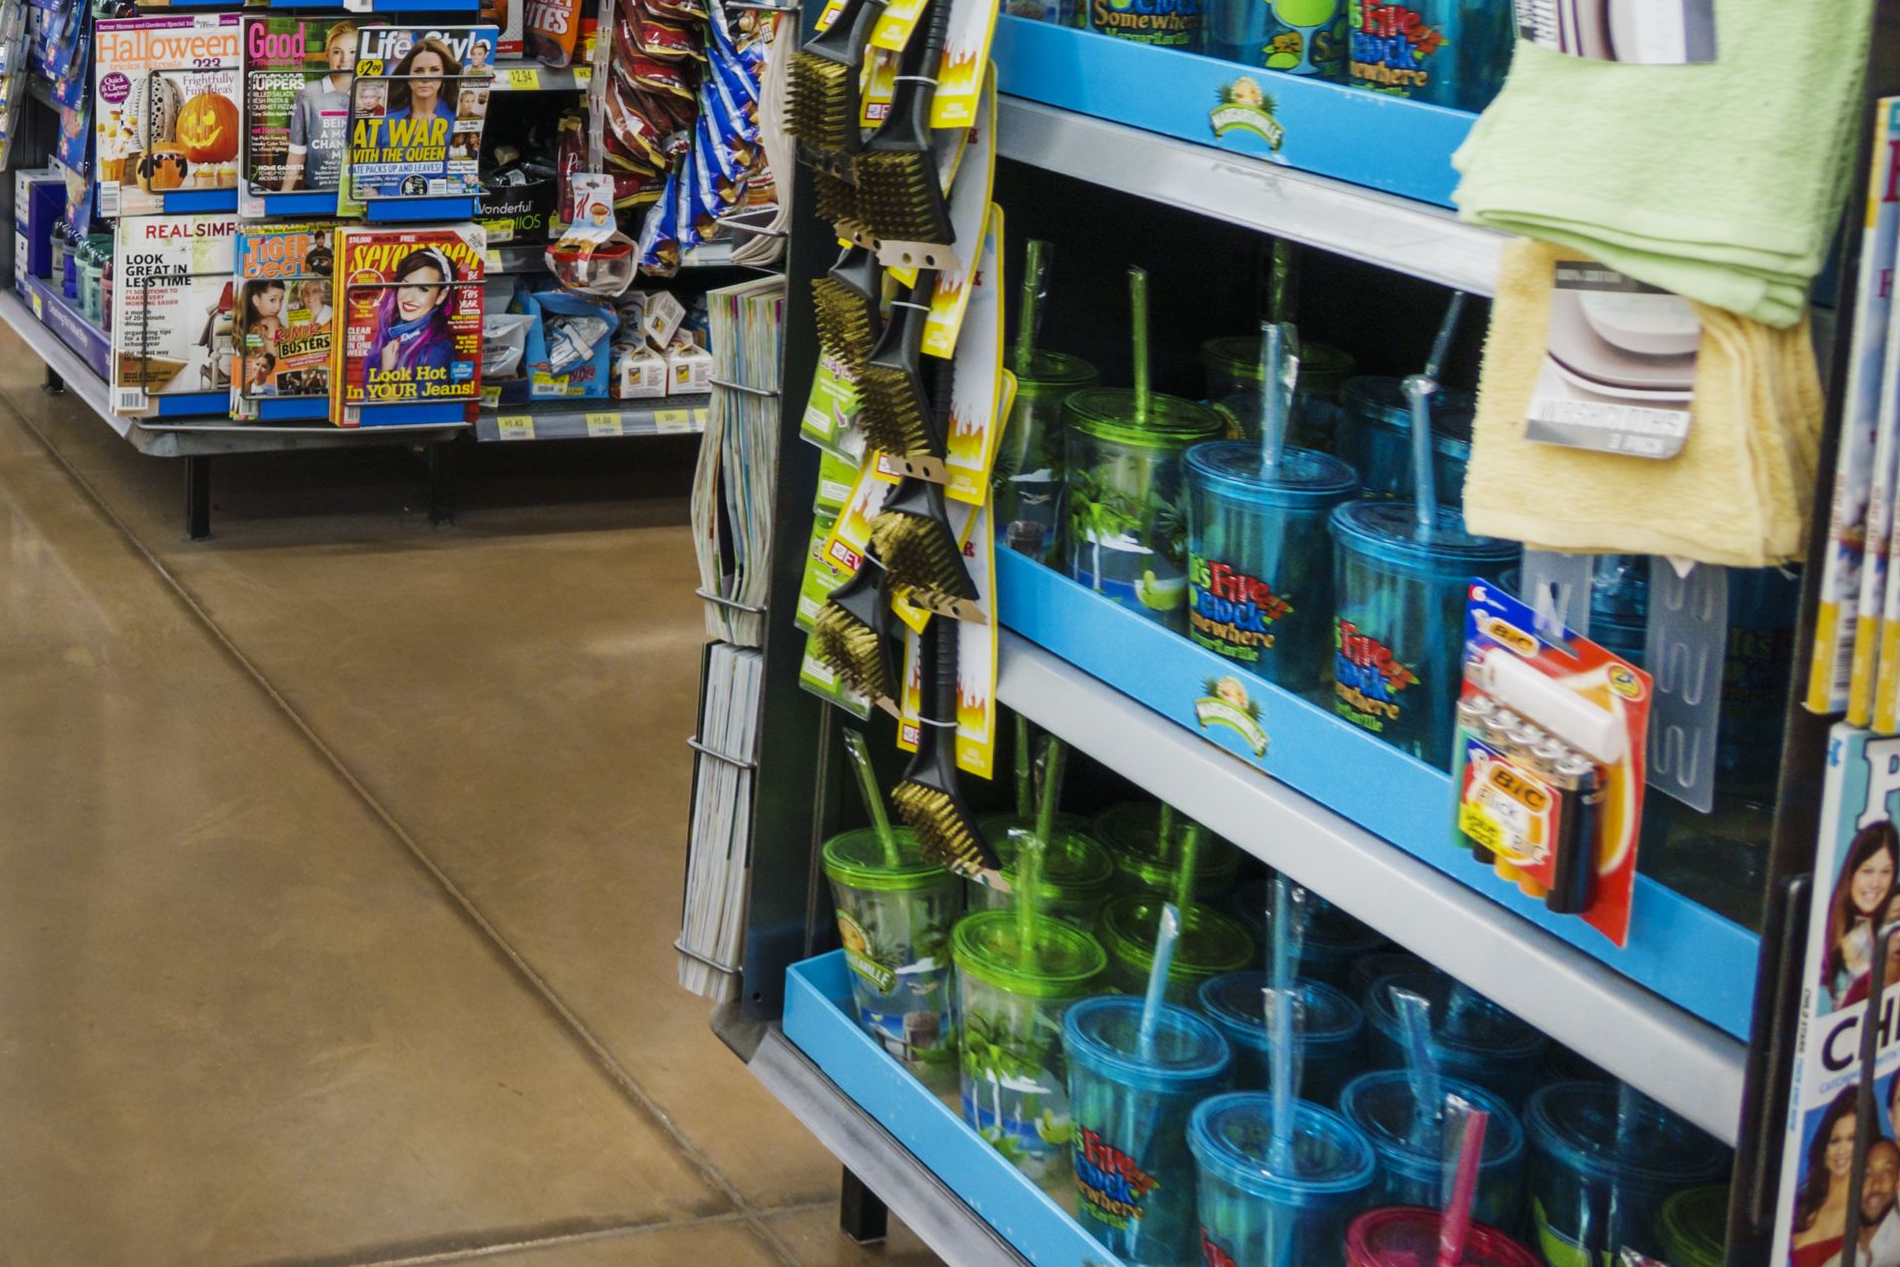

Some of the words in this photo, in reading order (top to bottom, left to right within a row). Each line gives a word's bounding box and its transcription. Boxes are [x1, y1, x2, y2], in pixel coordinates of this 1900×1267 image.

[96, 29, 239, 62] Halloween
[249, 22, 305, 58] Good
[360, 32, 411, 59] Life
[104, 76, 124, 84] Quick
[353, 119, 382, 148] AT
[388, 118, 448, 147] WAR
[382, 148, 403, 162] THE
[406, 148, 446, 162] QUEEN
[365, 164, 387, 173] PACKS
[146, 224, 193, 238] REAL
[126, 254, 163, 264] LOOK
[126, 265, 170, 276] GREAT
[174, 264, 187, 274] IN
[161, 276, 192, 286] TIME
[282, 335, 330, 356] BUSTERS
[369, 368, 412, 382] Look
[416, 367, 447, 381] Hot
[346, 386, 364, 399] In
[367, 385, 417, 397] YOUR
[421, 381, 474, 396] Jeans!
